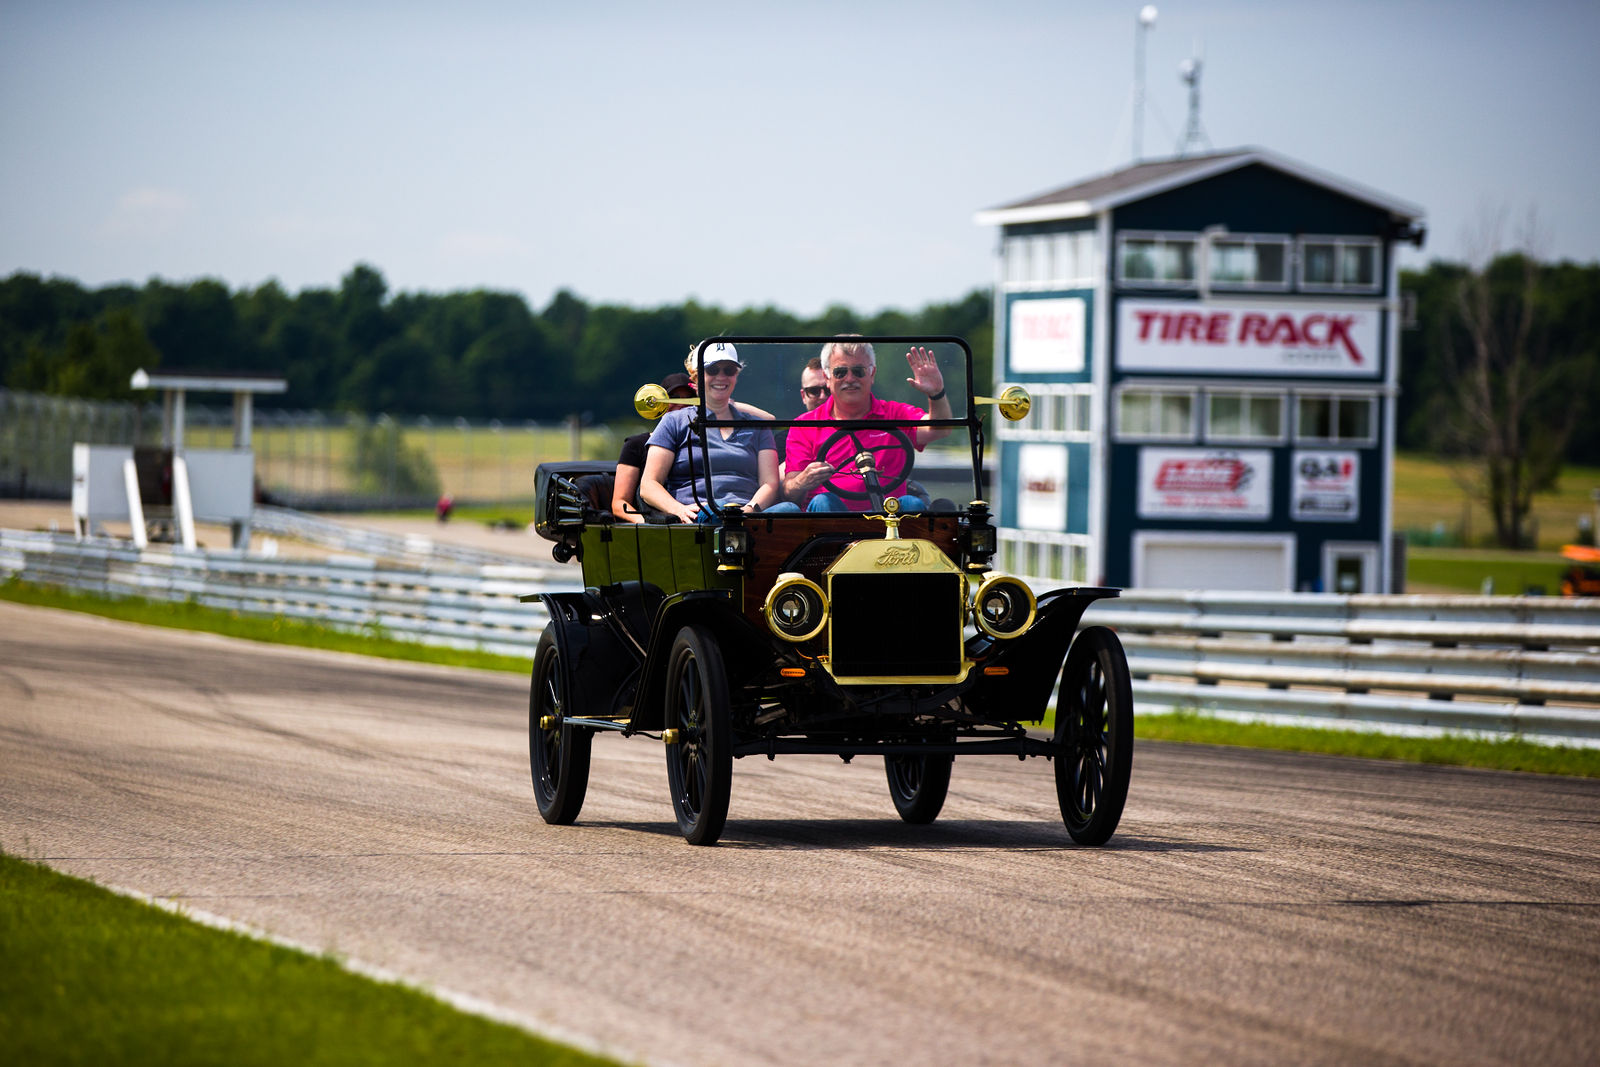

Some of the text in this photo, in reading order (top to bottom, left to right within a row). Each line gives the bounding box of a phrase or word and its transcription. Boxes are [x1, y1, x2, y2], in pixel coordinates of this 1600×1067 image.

[1134, 309, 1364, 364] TIRE RACK
[877, 544, 919, 566] Ford
